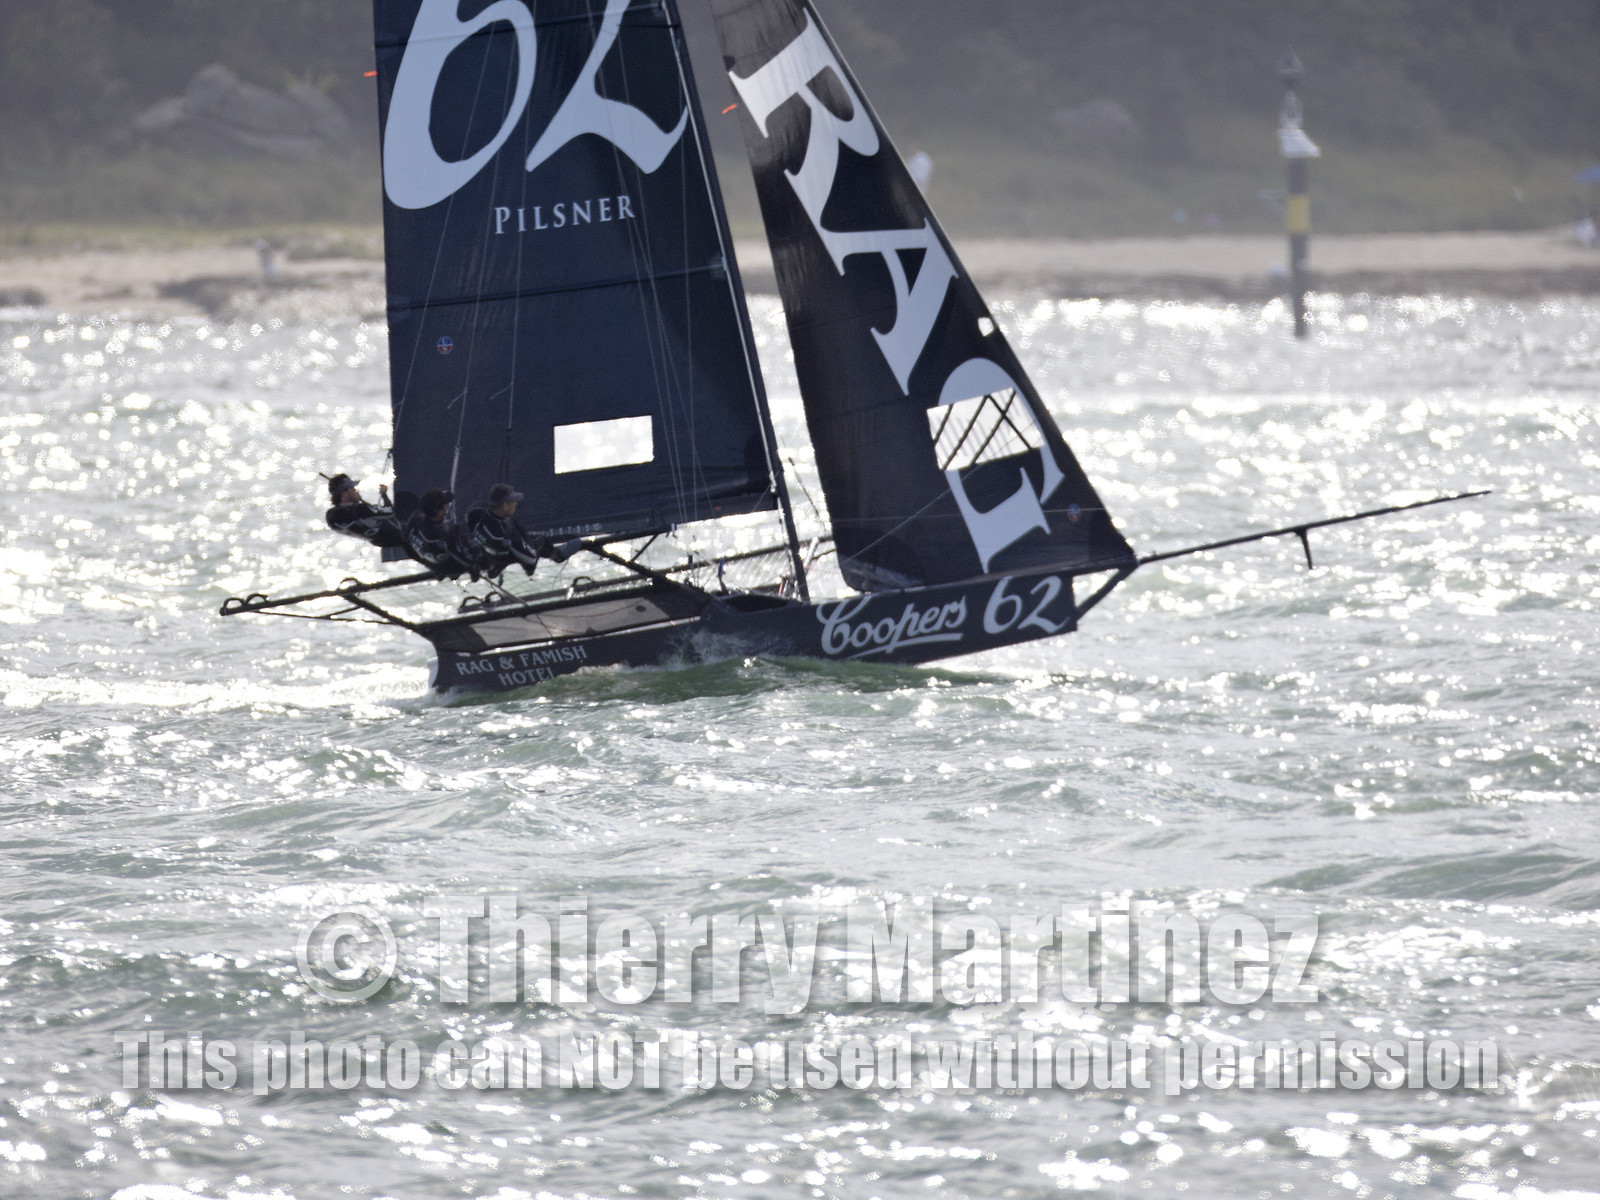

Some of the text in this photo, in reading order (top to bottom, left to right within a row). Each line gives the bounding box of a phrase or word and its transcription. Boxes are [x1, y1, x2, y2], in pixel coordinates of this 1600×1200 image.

[494, 195, 636, 235] PILSNER
[729, 7, 1065, 574] RAG
[816, 576, 1070, 655] Coopers 62
[456, 645, 588, 676] RAG & FAMISH
